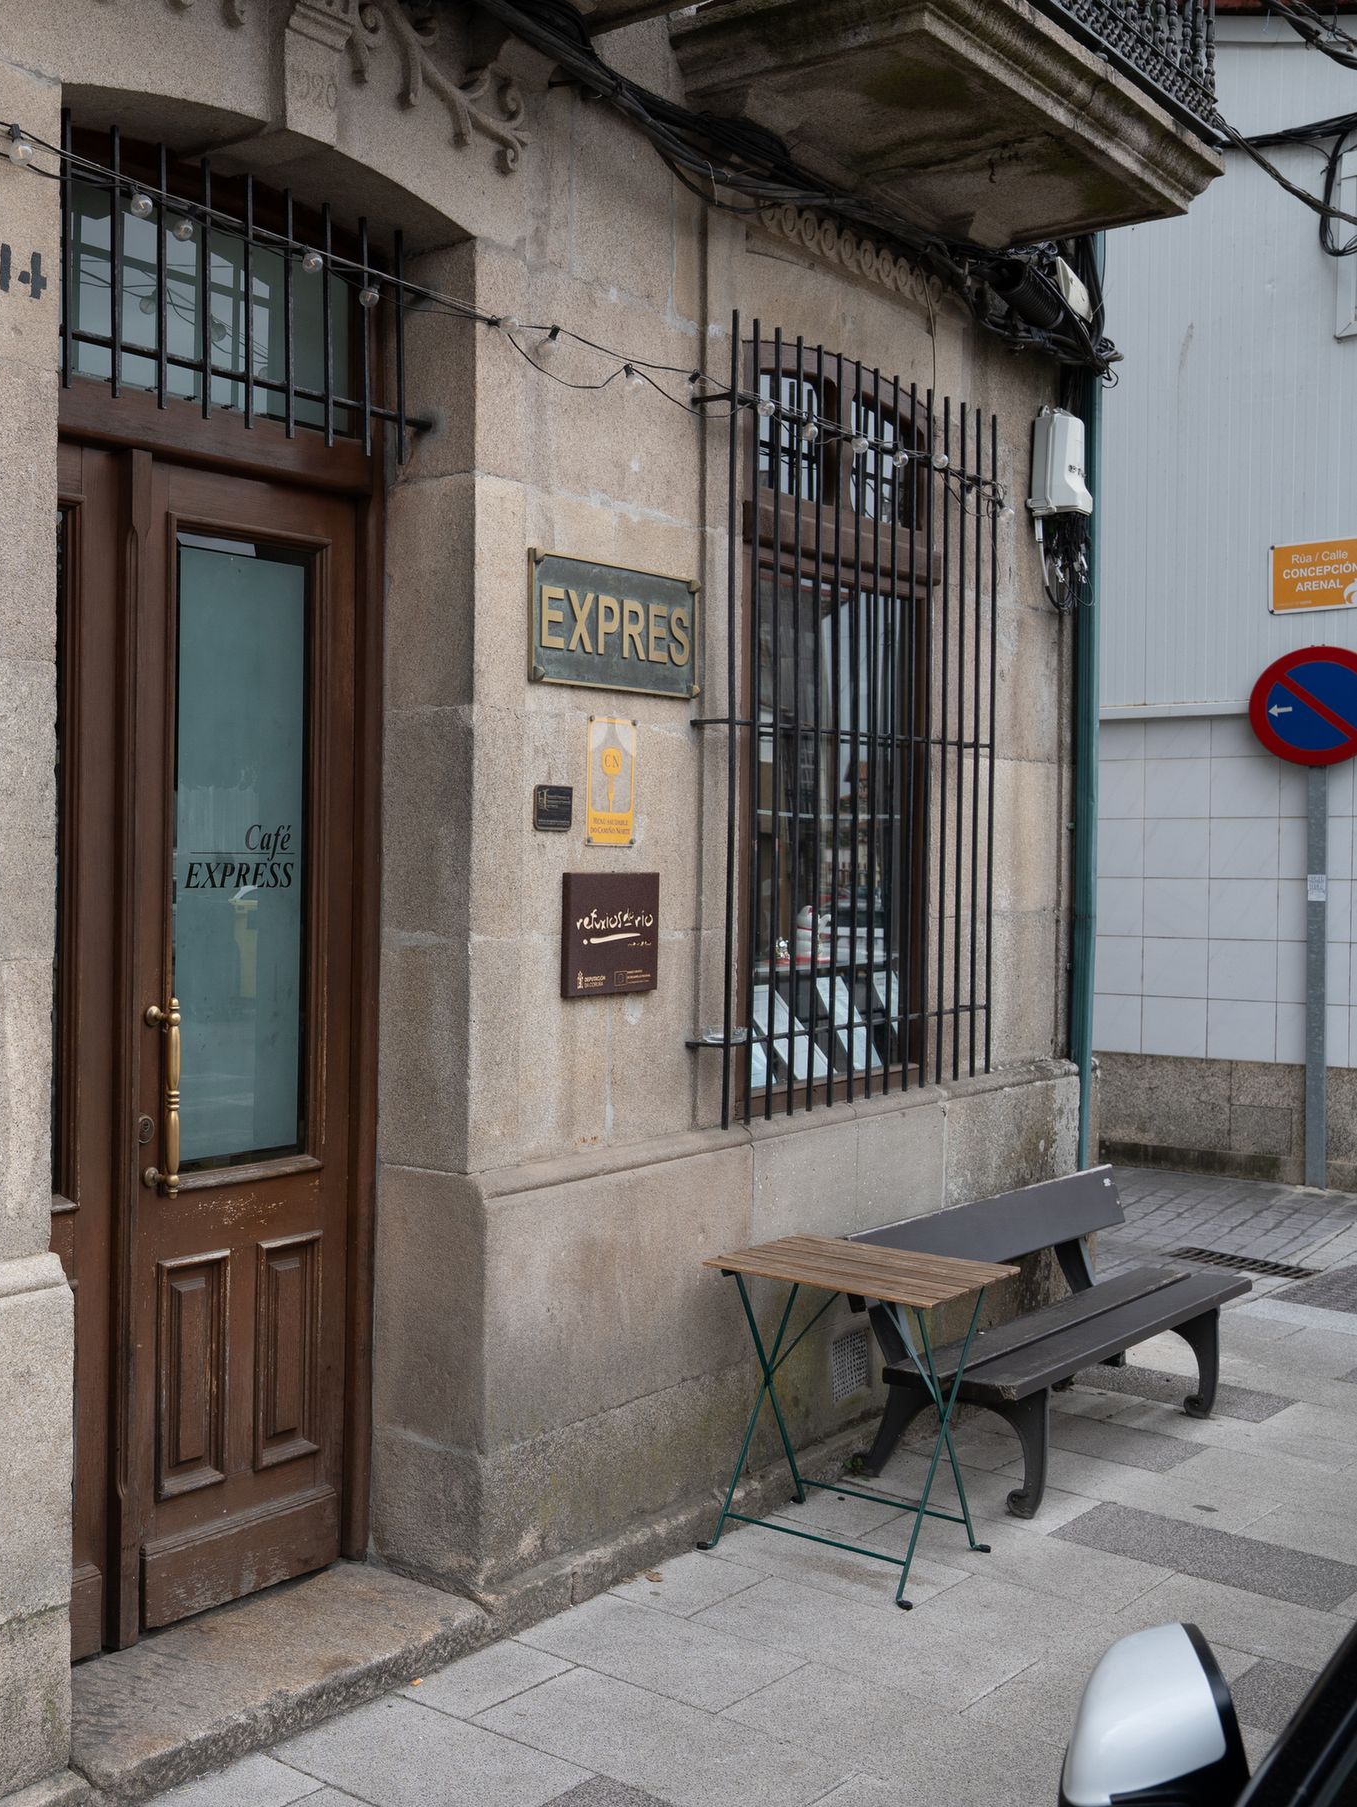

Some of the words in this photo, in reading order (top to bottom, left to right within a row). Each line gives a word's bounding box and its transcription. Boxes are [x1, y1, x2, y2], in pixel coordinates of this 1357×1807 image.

[1291, 553, 1313, 564] Rúa
[1321, 549, 1348, 561] Calle
[1282, 561, 1357, 579] CONCEPCIÓN
[1295, 578, 1344, 592] ARENAL
[540, 585, 690, 666] EXPRES
[245, 824, 292, 861] Café
[184, 862, 294, 888] EXPRESS
